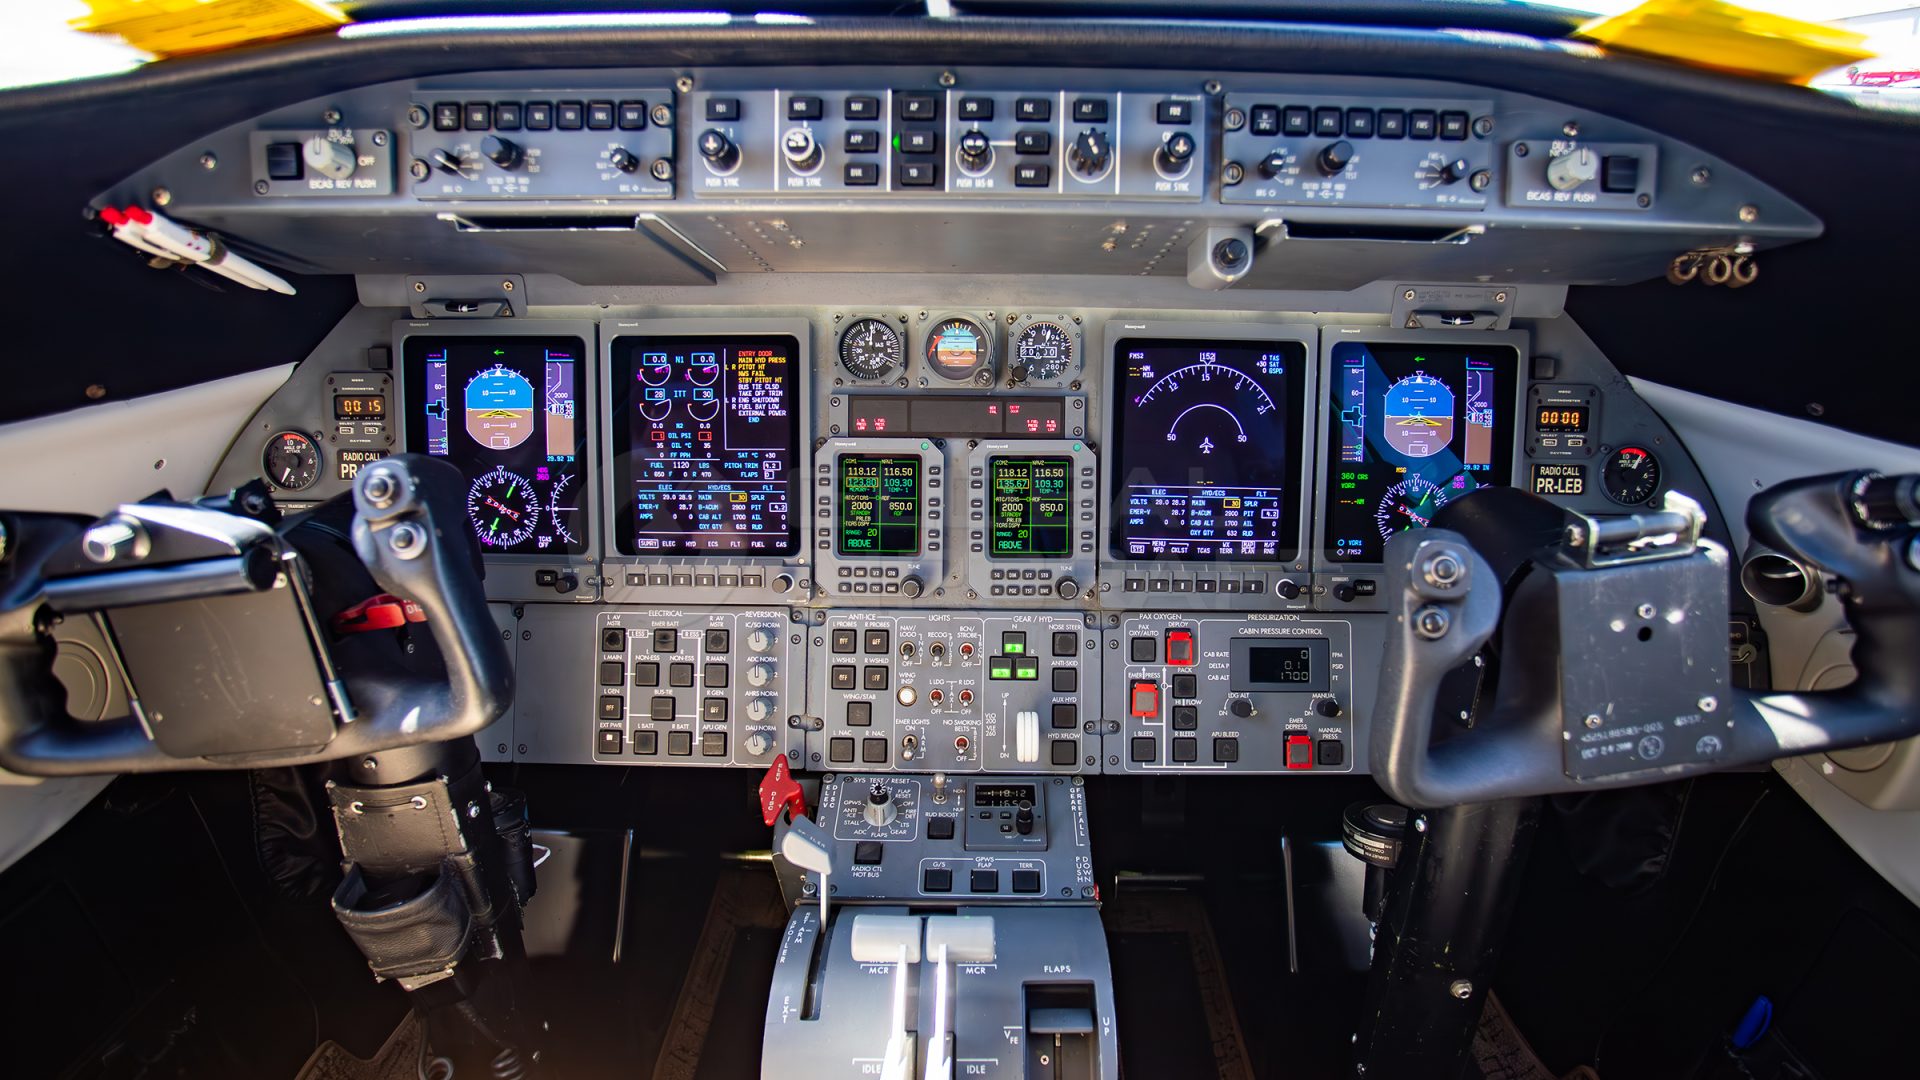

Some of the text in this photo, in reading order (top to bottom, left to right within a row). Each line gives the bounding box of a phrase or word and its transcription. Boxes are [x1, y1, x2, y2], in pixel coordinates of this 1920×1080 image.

[706, 178, 721, 186] PUSH
[788, 178, 803, 186] PUSH
[1156, 182, 1171, 191] PUSH
[1573, 194, 1596, 202] PUSH
[343, 453, 381, 461] RADIO CALL
[884, 468, 912, 476] 116.50
[998, 469, 1027, 477] 118.12
[1035, 469, 1063, 477] 116.50
[1540, 467, 1579, 476] RADIO CALL
[884, 478, 912, 486] 109.30
[999, 480, 1027, 488] 135.67
[1035, 480, 1063, 488] 109.30
[1537, 479, 1582, 493] PR-LEB
[851, 502, 872, 510] 2000
[889, 502, 912, 510] 850.0
[1018, 530, 1028, 538] 20
[1281, 672, 1308, 680] 1700
[780, 921, 796, 963] SPOILER
[1044, 965, 1071, 973] FLAPS
[966, 1065, 986, 1074] IDLE
